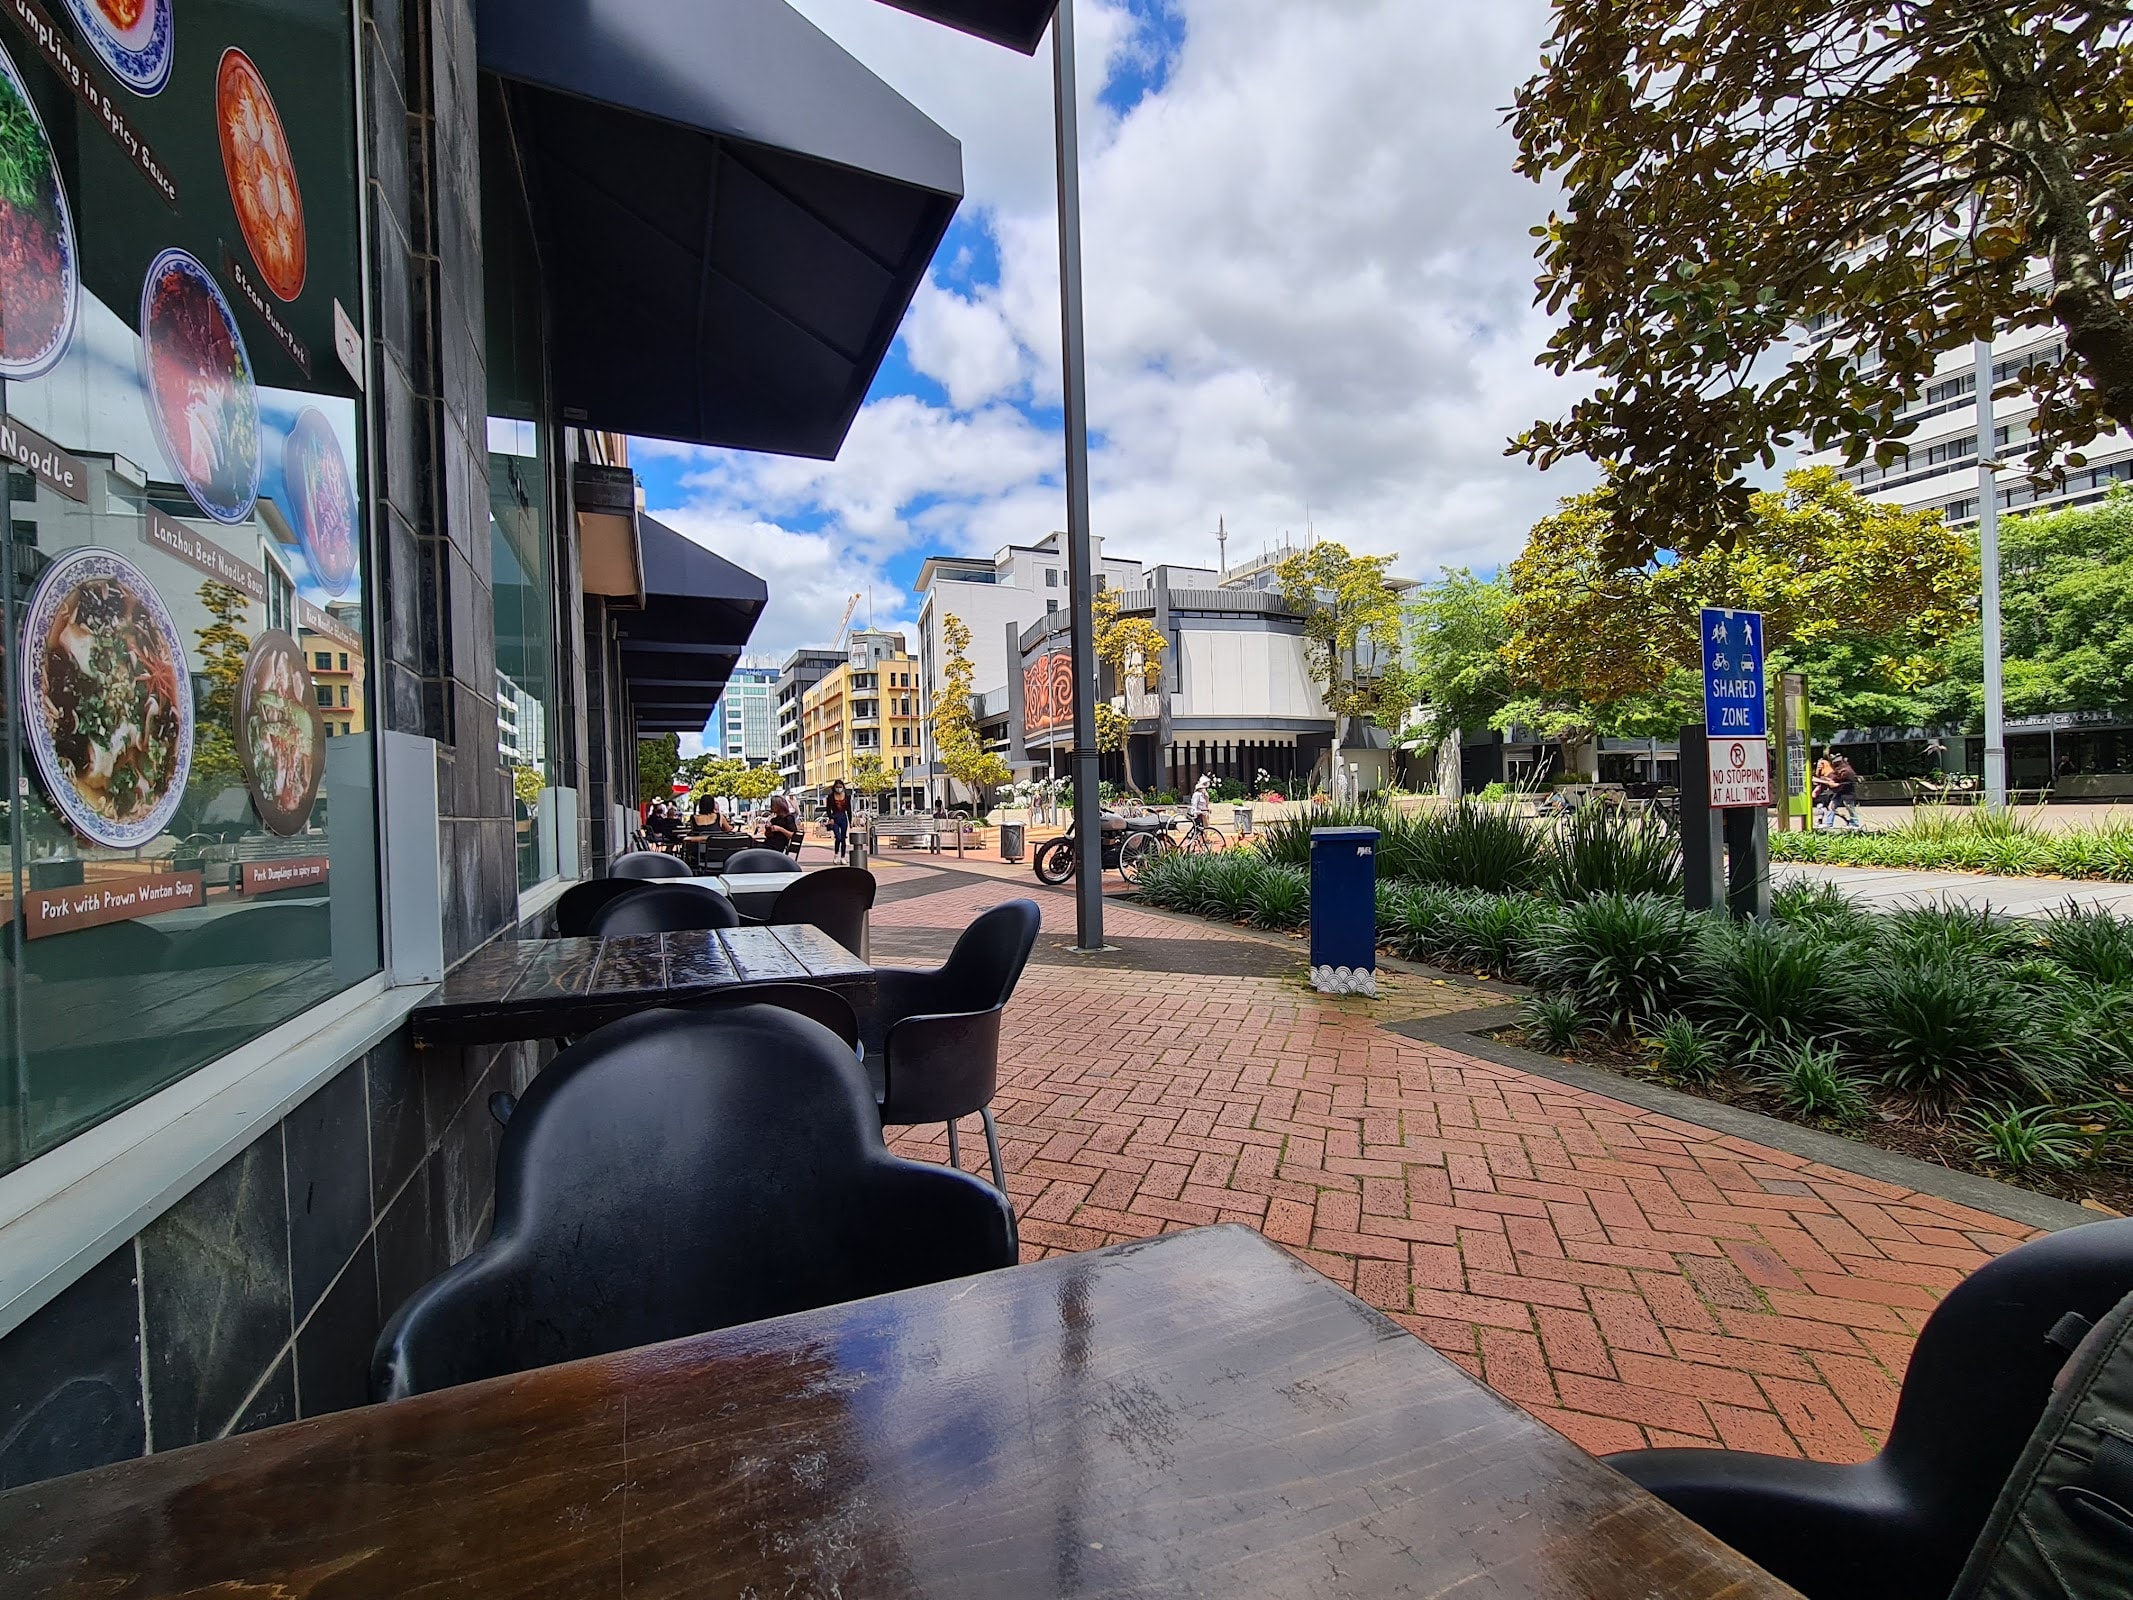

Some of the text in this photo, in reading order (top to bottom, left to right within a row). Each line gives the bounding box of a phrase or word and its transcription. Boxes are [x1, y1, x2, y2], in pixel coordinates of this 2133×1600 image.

[83, 72, 98, 106] in
[102, 97, 138, 157] Spicy
[141, 146, 176, 200] Sauce
[235, 264, 265, 313] Steam
[1, 425, 74, 488] Noodle
[153, 516, 264, 600] Lanzhou Beef Noodle Soup
[1712, 678, 1757, 699] SHARED
[1721, 707, 1751, 727] ZONE
[2054, 714, 2074, 724] City
[1712, 768, 1765, 785] NO STOPPING
[1713, 786, 1767, 804] AT ALL TIMES
[41, 880, 194, 920] Pork with Prown Wonton Soup
